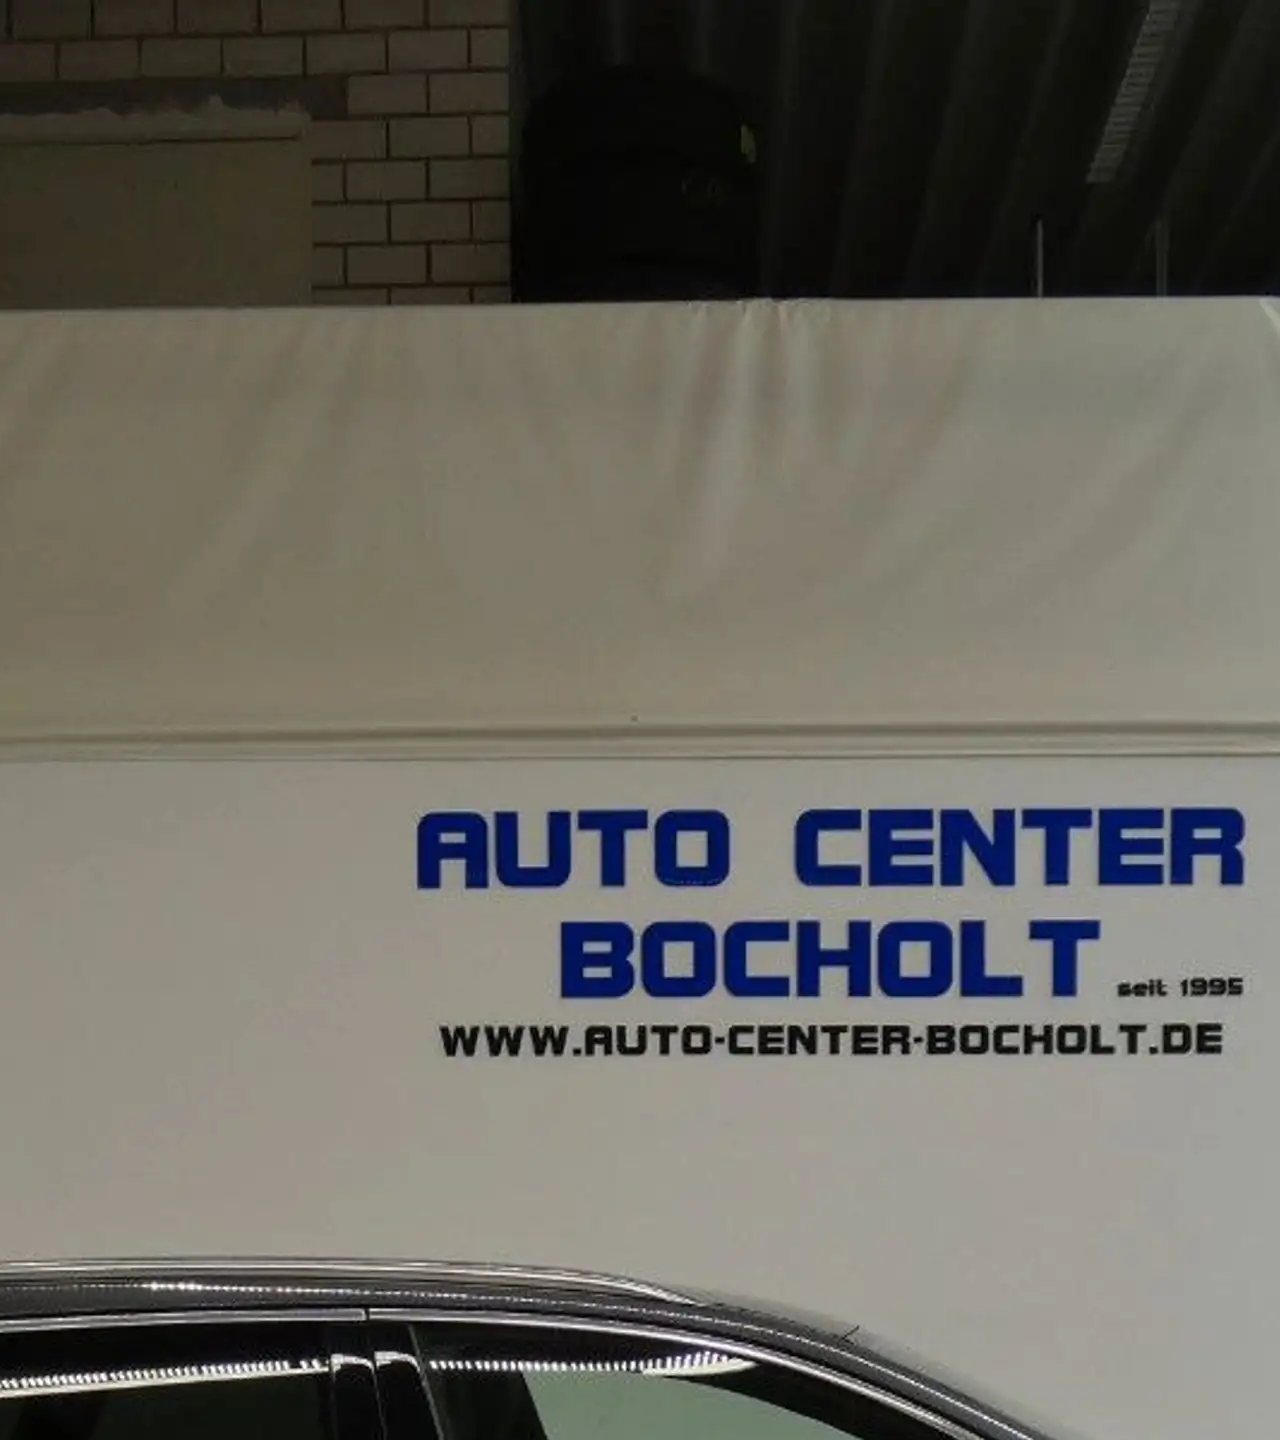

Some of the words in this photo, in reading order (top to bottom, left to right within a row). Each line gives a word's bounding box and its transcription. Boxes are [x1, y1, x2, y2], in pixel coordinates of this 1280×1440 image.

[417, 808, 732, 890] AUTO
[794, 806, 1246, 889] CENTER
[561, 919, 1103, 1001] BOCHOLT
[1116, 977, 1169, 999] seit
[1179, 976, 1245, 998] 1995
[438, 1022, 1224, 1059] WWW.AUTO-CENTER-BOCHOLT.DE
